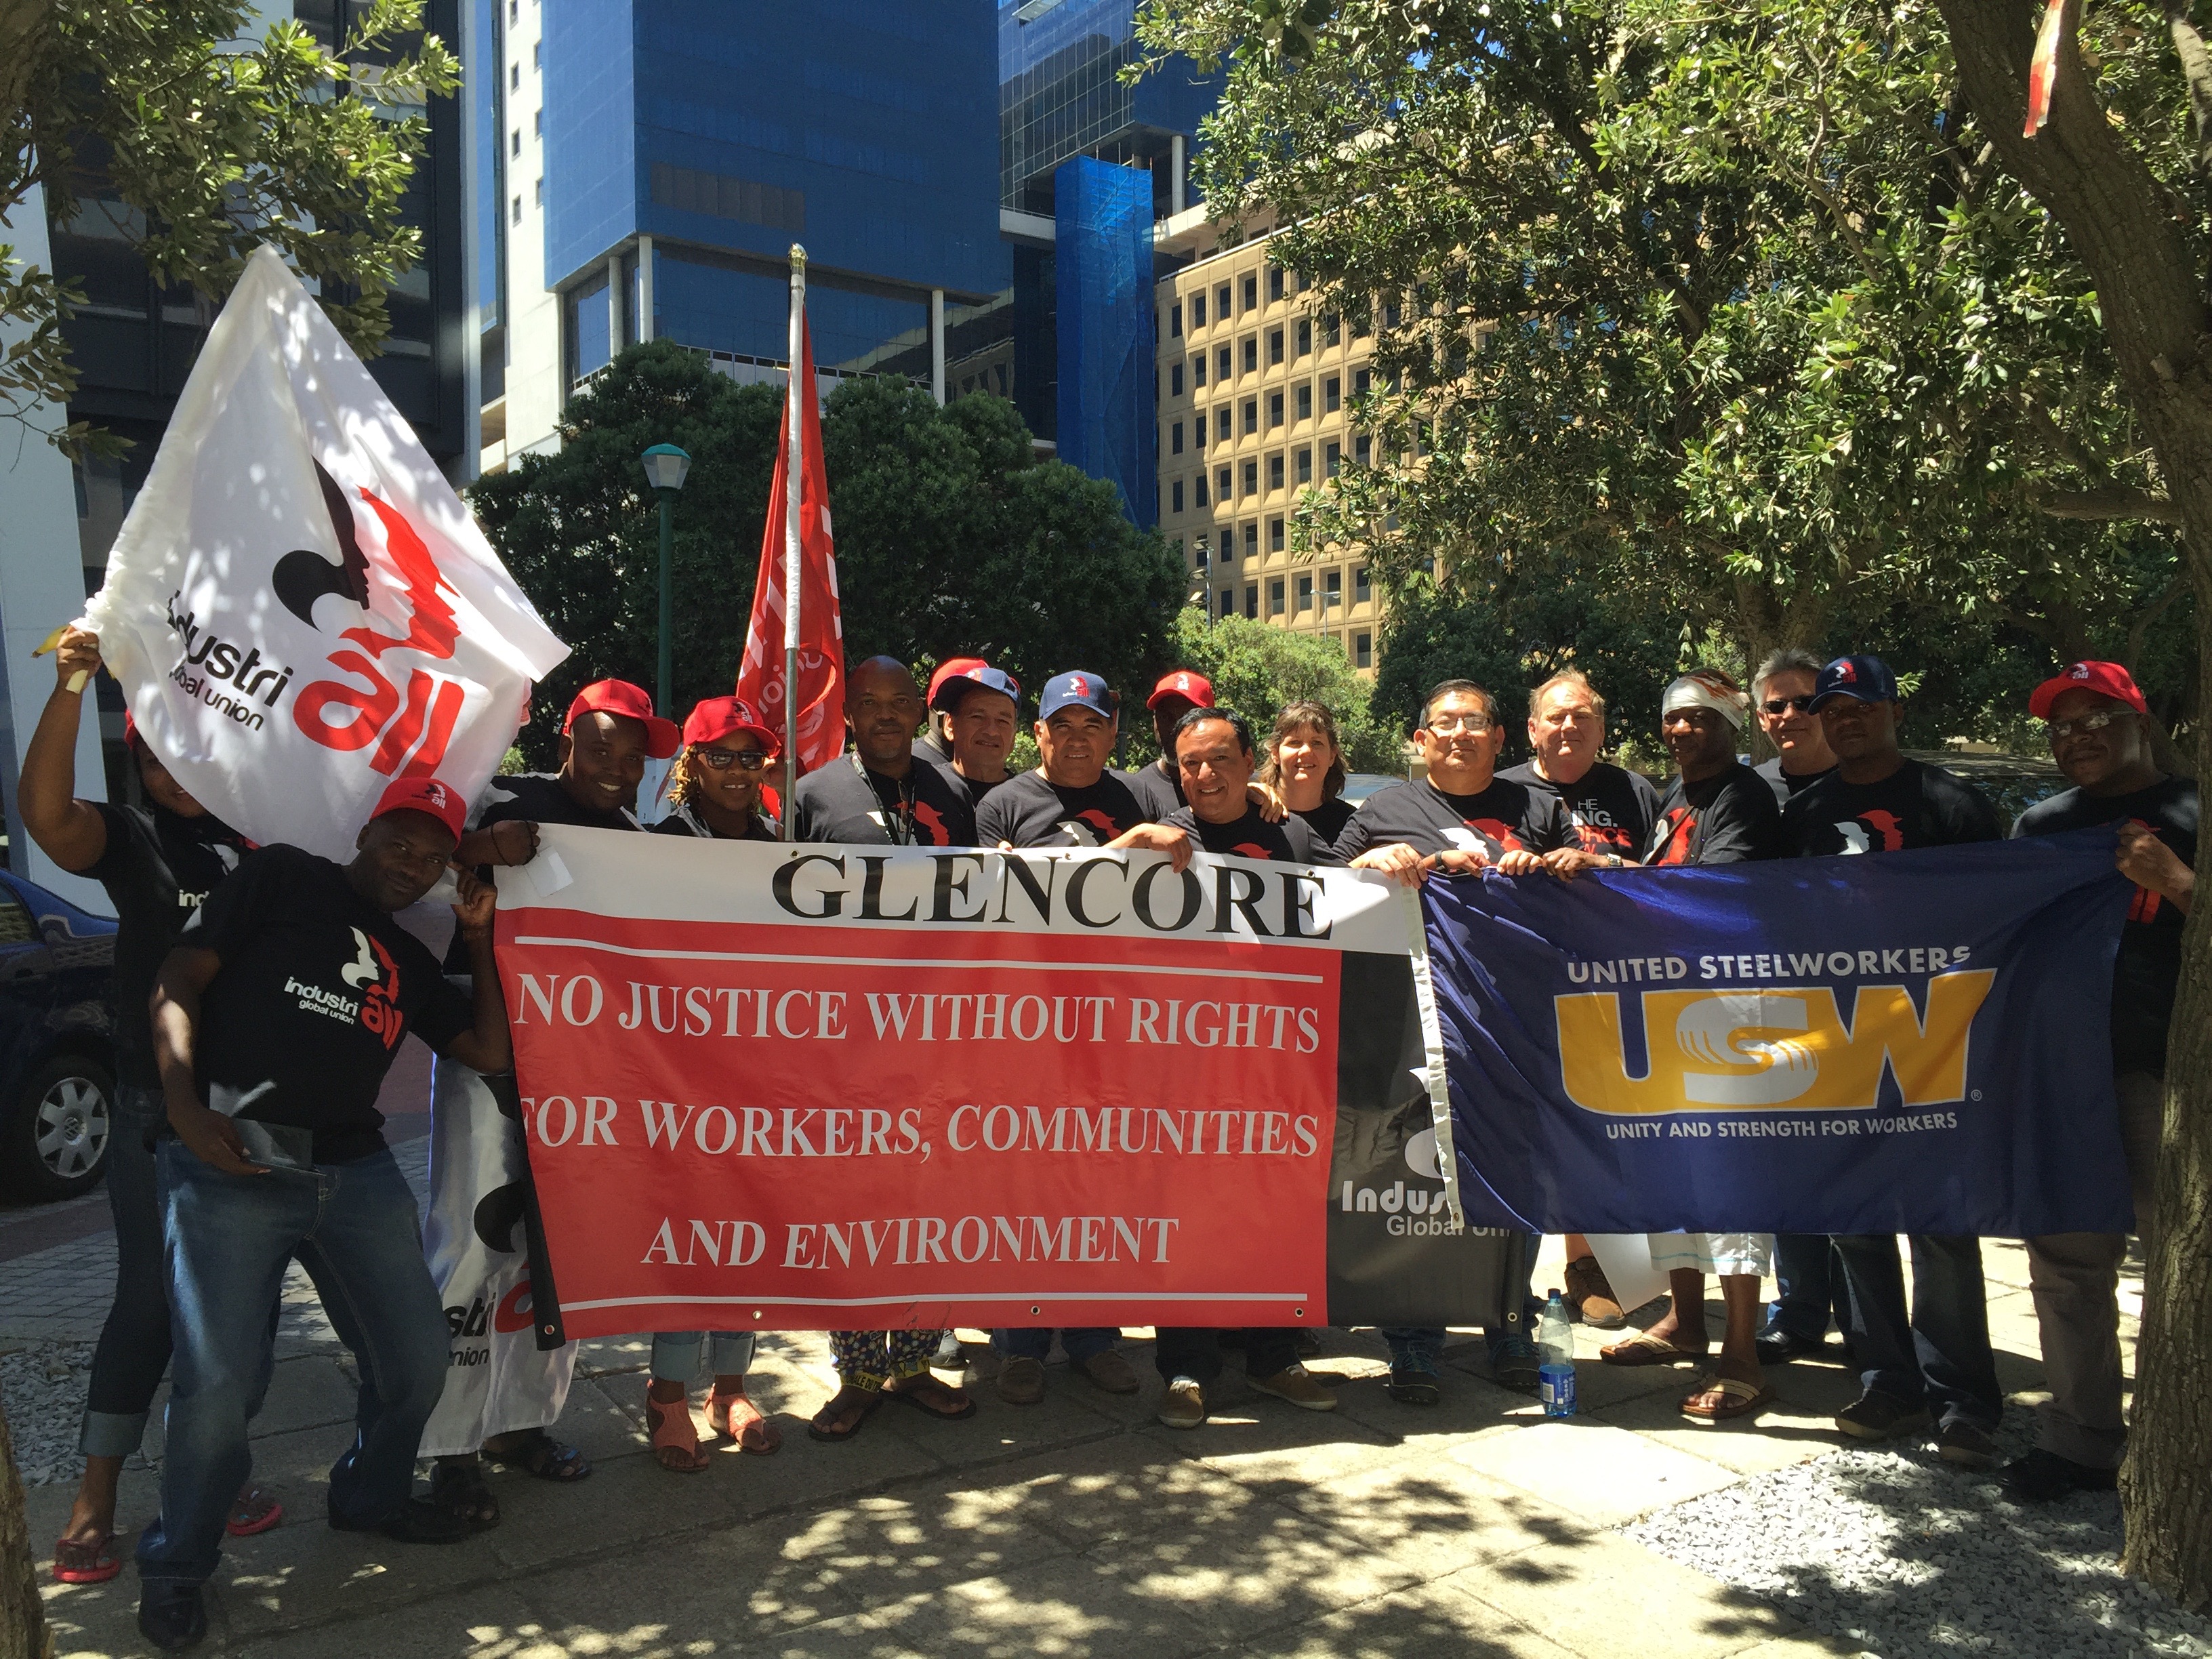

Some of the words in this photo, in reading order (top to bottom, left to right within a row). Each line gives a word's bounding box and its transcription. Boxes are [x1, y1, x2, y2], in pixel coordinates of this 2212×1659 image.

[204, 688, 264, 731] union
[772, 853, 1332, 941] GLENCORE
[1567, 956, 1687, 983] UNITED
[1699, 945, 1971, 979] STEELWORKERS
[284, 976, 359, 1017] industri
[299, 1000, 329, 1016] global
[329, 1009, 354, 1025] union
[514, 973, 604, 1026] NO
[618, 981, 848, 1040] JUSTICE
[863, 992, 1115, 1043] WITHOUT
[1125, 998, 1320, 1054] RIGHTS
[1553, 967, 1999, 1118] USW
[638, 1099, 931, 1164] WORKERS,
[947, 1104, 1319, 1157] COMMUNITIES
[1606, 1122, 1662, 1140] UNITY
[1668, 1122, 1712, 1139] AND
[1718, 1120, 1816, 1137] STRENGTH
[1821, 1119, 1860, 1136] FOR
[1865, 1112, 1958, 1135] WORKERS
[640, 1216, 766, 1267] AND
[779, 1215, 1179, 1269] ENVIRONMENT
[1386, 1214, 1464, 1236] Globa
